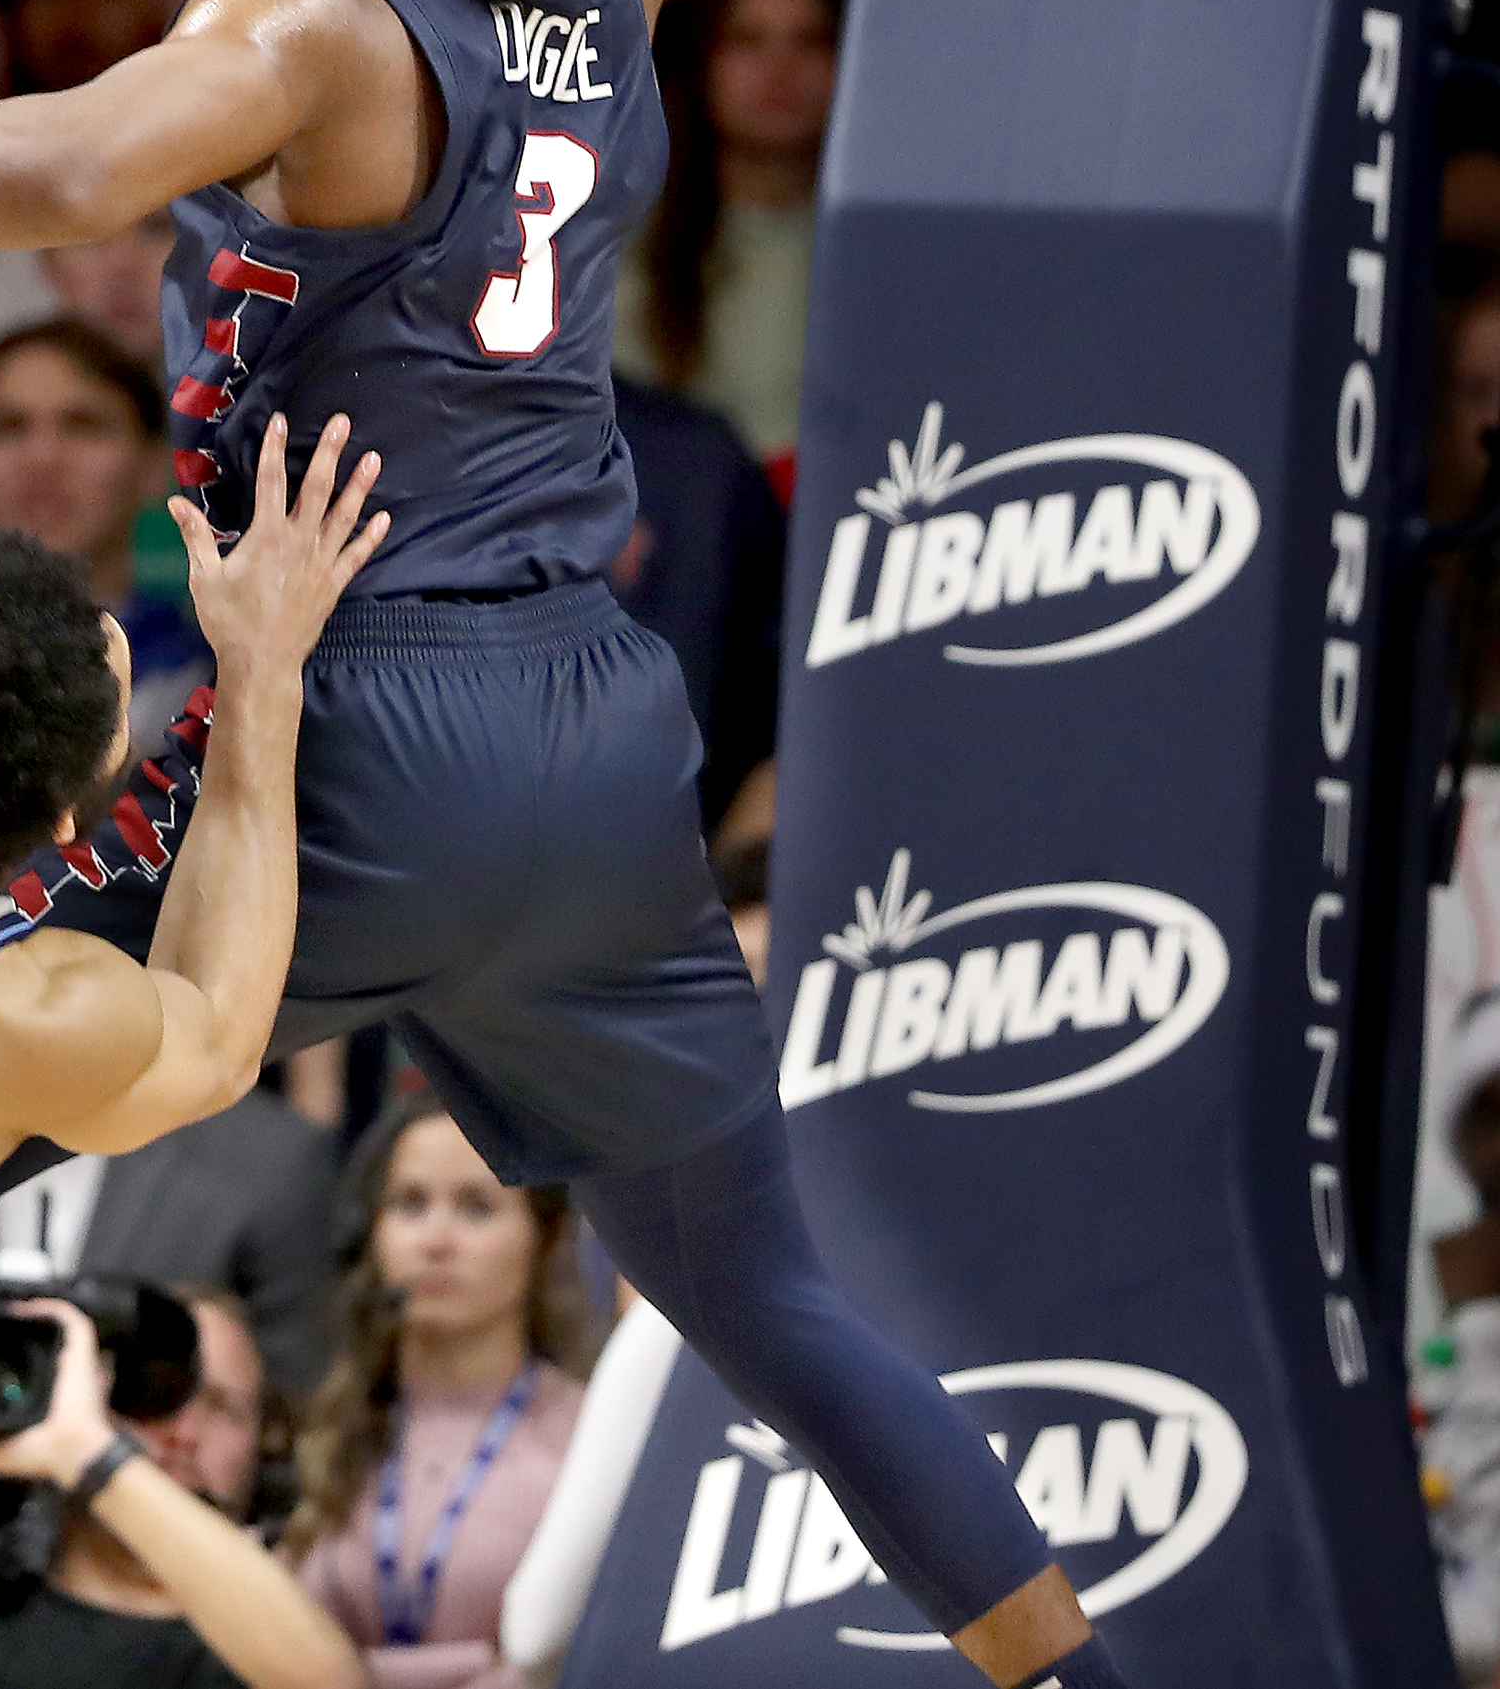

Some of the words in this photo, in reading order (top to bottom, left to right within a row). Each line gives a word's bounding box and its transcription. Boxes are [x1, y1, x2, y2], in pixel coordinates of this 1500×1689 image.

[469, 129, 601, 359] 3
[805, 478, 1218, 669] LIBMAN
[777, 925, 1187, 1112] LIBMAN
[659, 1416, 1195, 1652] LIBAN
